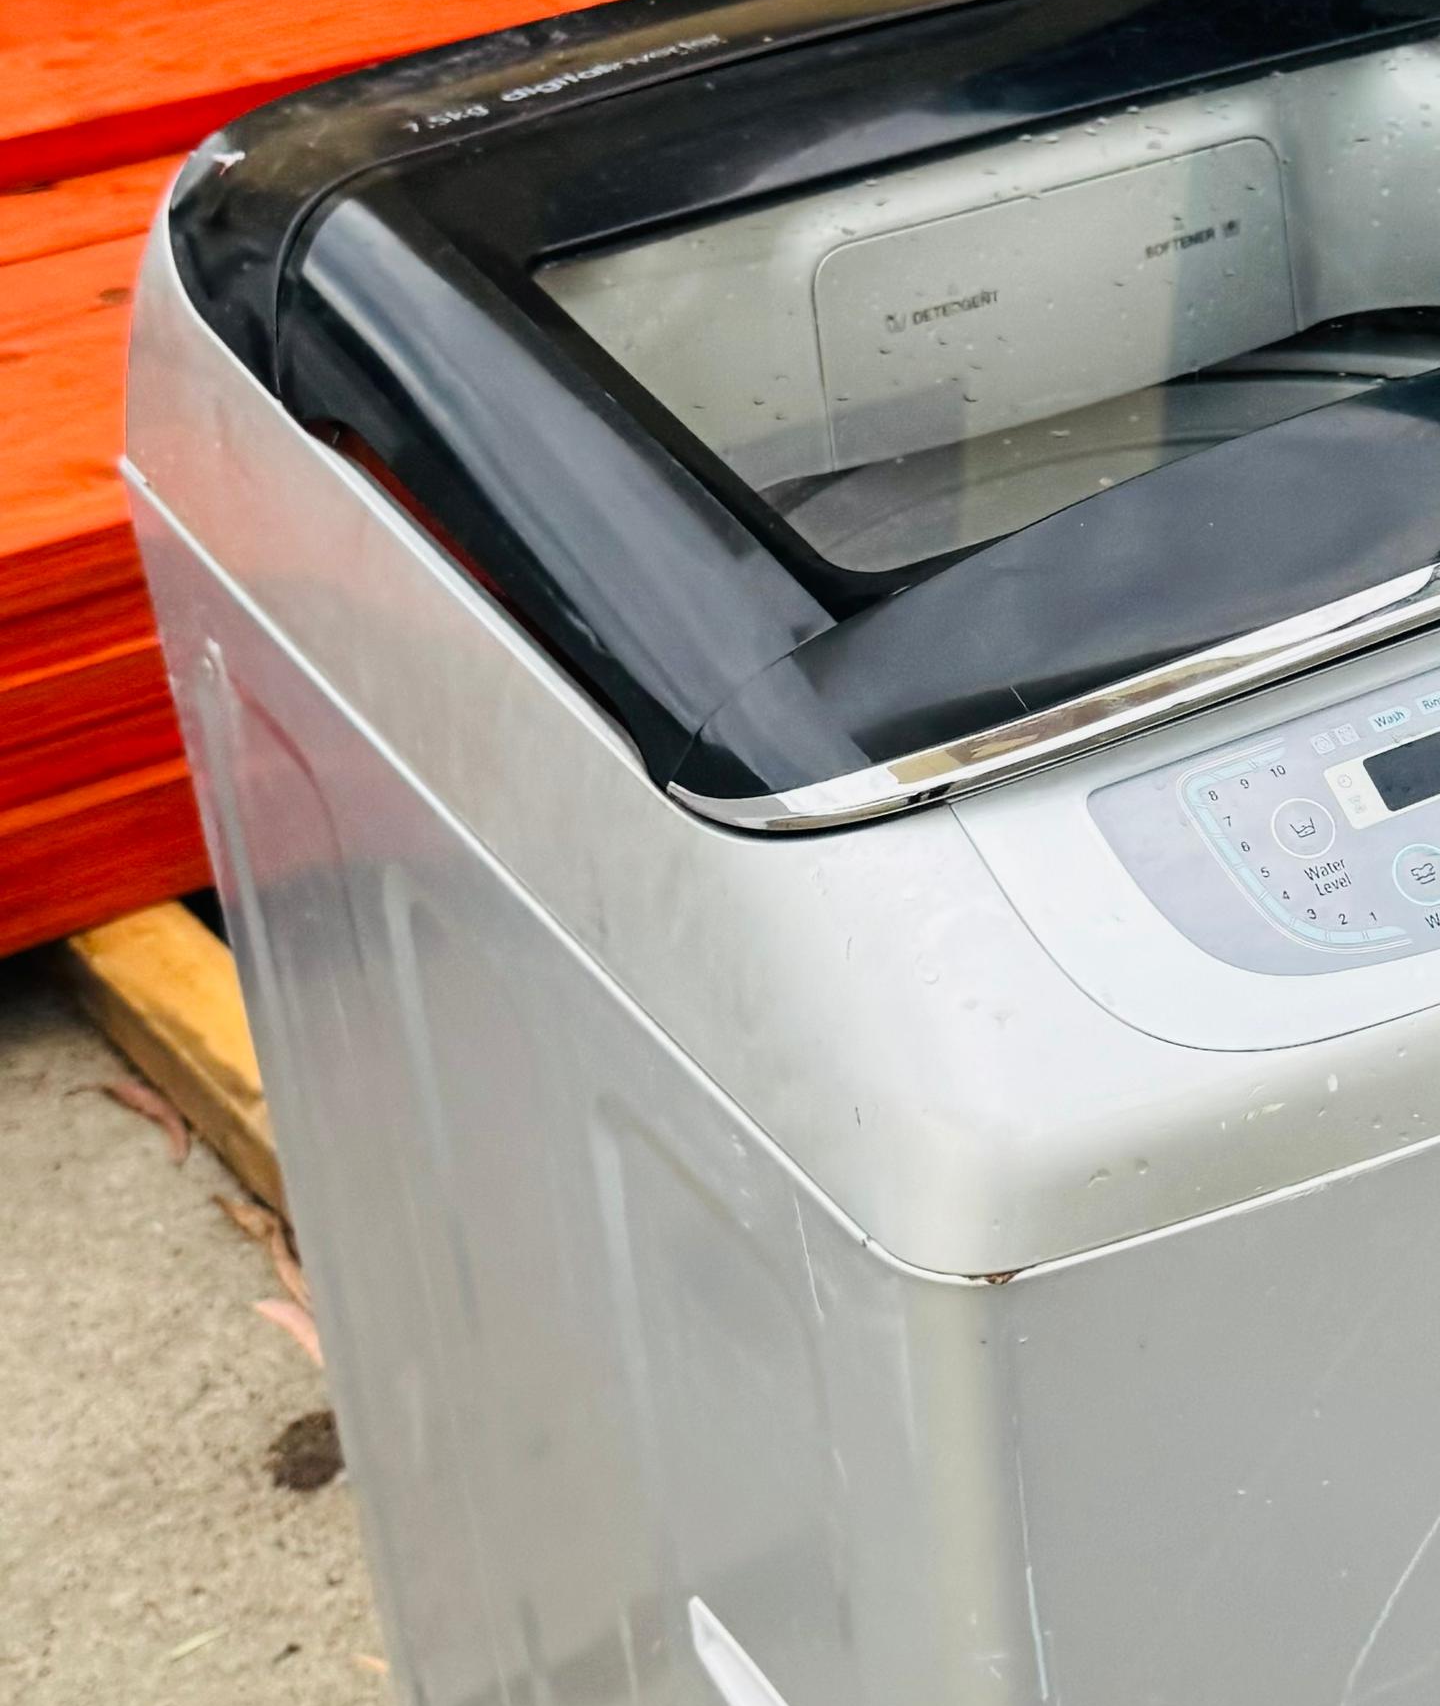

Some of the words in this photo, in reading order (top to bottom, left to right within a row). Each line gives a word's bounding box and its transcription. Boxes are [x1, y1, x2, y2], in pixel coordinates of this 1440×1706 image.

[1373, 709, 1407, 730] Wash
[1269, 764, 1287, 779] 10
[1239, 778, 1251, 790] 9
[1208, 789, 1219, 802] 8
[1222, 814, 1233, 828] 7
[1239, 840, 1251, 853] 6
[1260, 866, 1271, 879] 5
[1303, 857, 1346, 882] Water
[1314, 872, 1352, 897] Level
[1281, 889, 1291, 901] 4
[1306, 907, 1318, 921] 3
[1337, 912, 1349, 926] 2
[1369, 910, 1379, 923] 1
